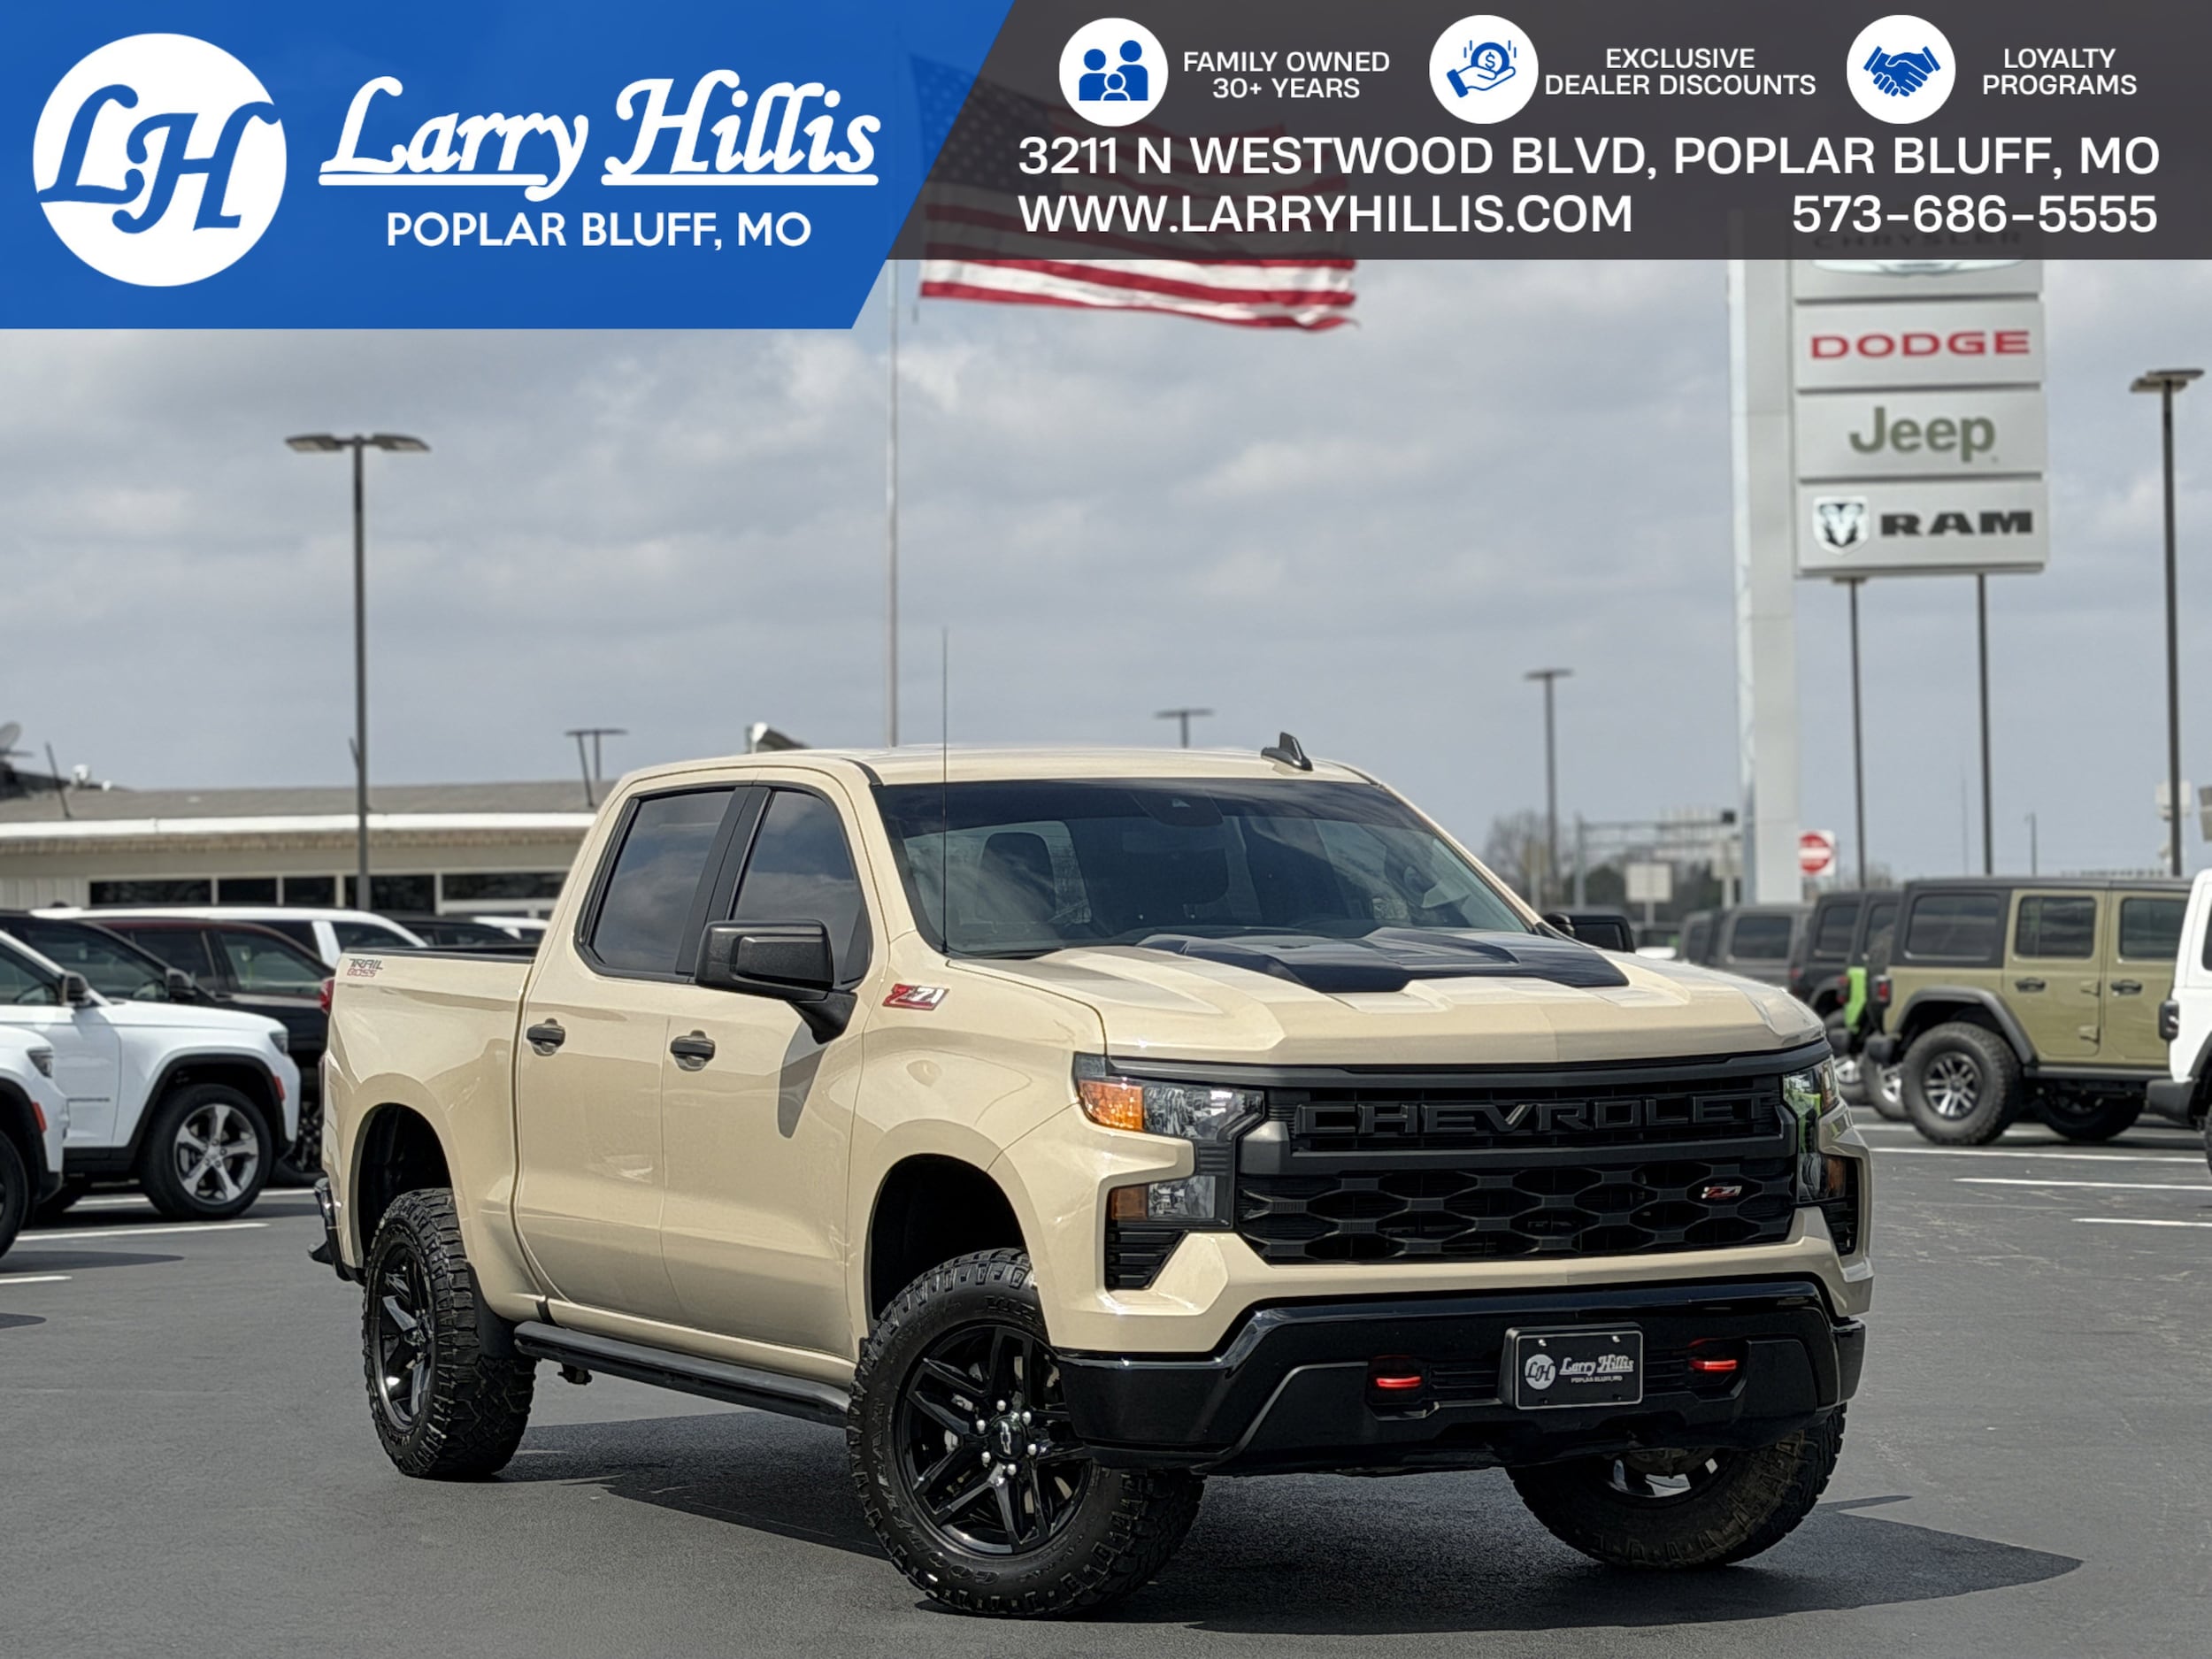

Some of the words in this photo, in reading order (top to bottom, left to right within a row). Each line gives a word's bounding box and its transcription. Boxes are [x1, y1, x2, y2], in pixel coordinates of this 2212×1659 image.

[1810, 329, 2031, 359] DODGE
[1848, 406, 1996, 463] Jeep
[1880, 511, 2033, 536] RAM
[346, 968, 378, 977] BOSS
[349, 958, 383, 970] TRAIL
[882, 983, 949, 1011] Z71
[1294, 1093, 1780, 1136] CHEVROLET
[1559, 1356, 1596, 1377] Larry
[1596, 1354, 1635, 1374] Hillis
